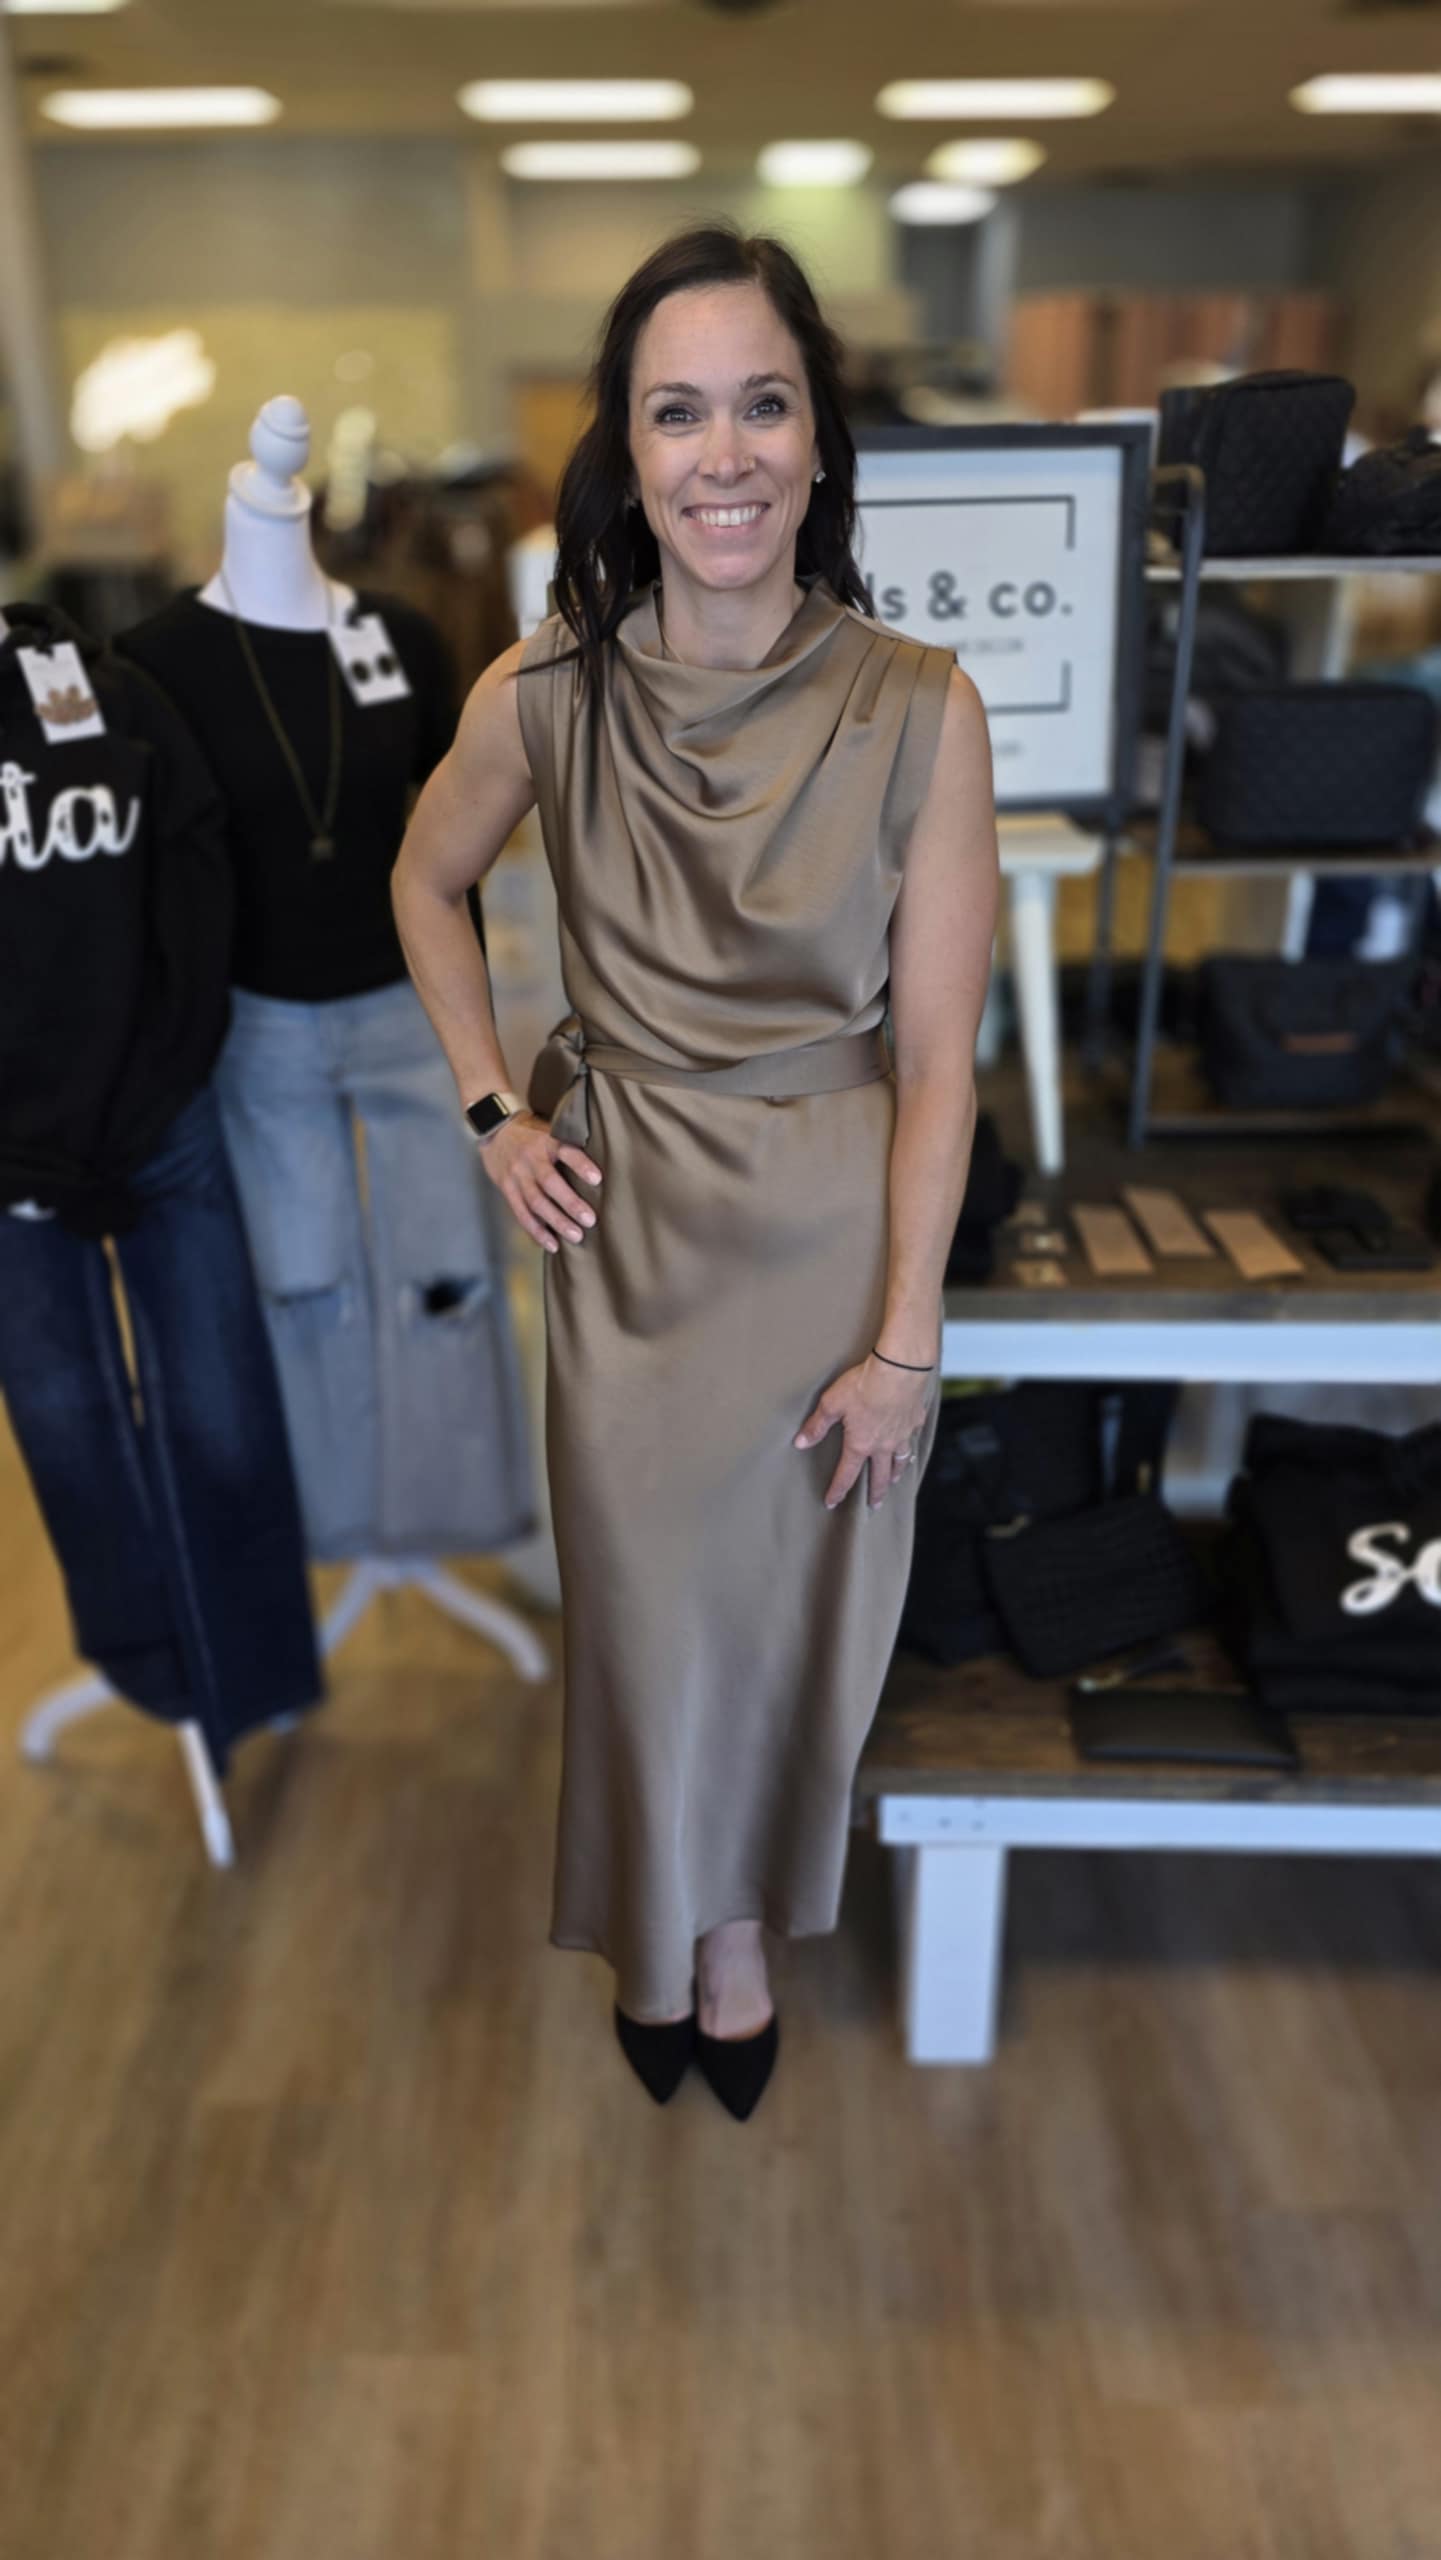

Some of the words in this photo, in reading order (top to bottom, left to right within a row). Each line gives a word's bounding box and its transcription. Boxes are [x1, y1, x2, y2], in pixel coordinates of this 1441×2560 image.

[928, 571, 966, 621] &
[987, 581, 1073, 619] co.
[0, 761, 140, 868] ta
